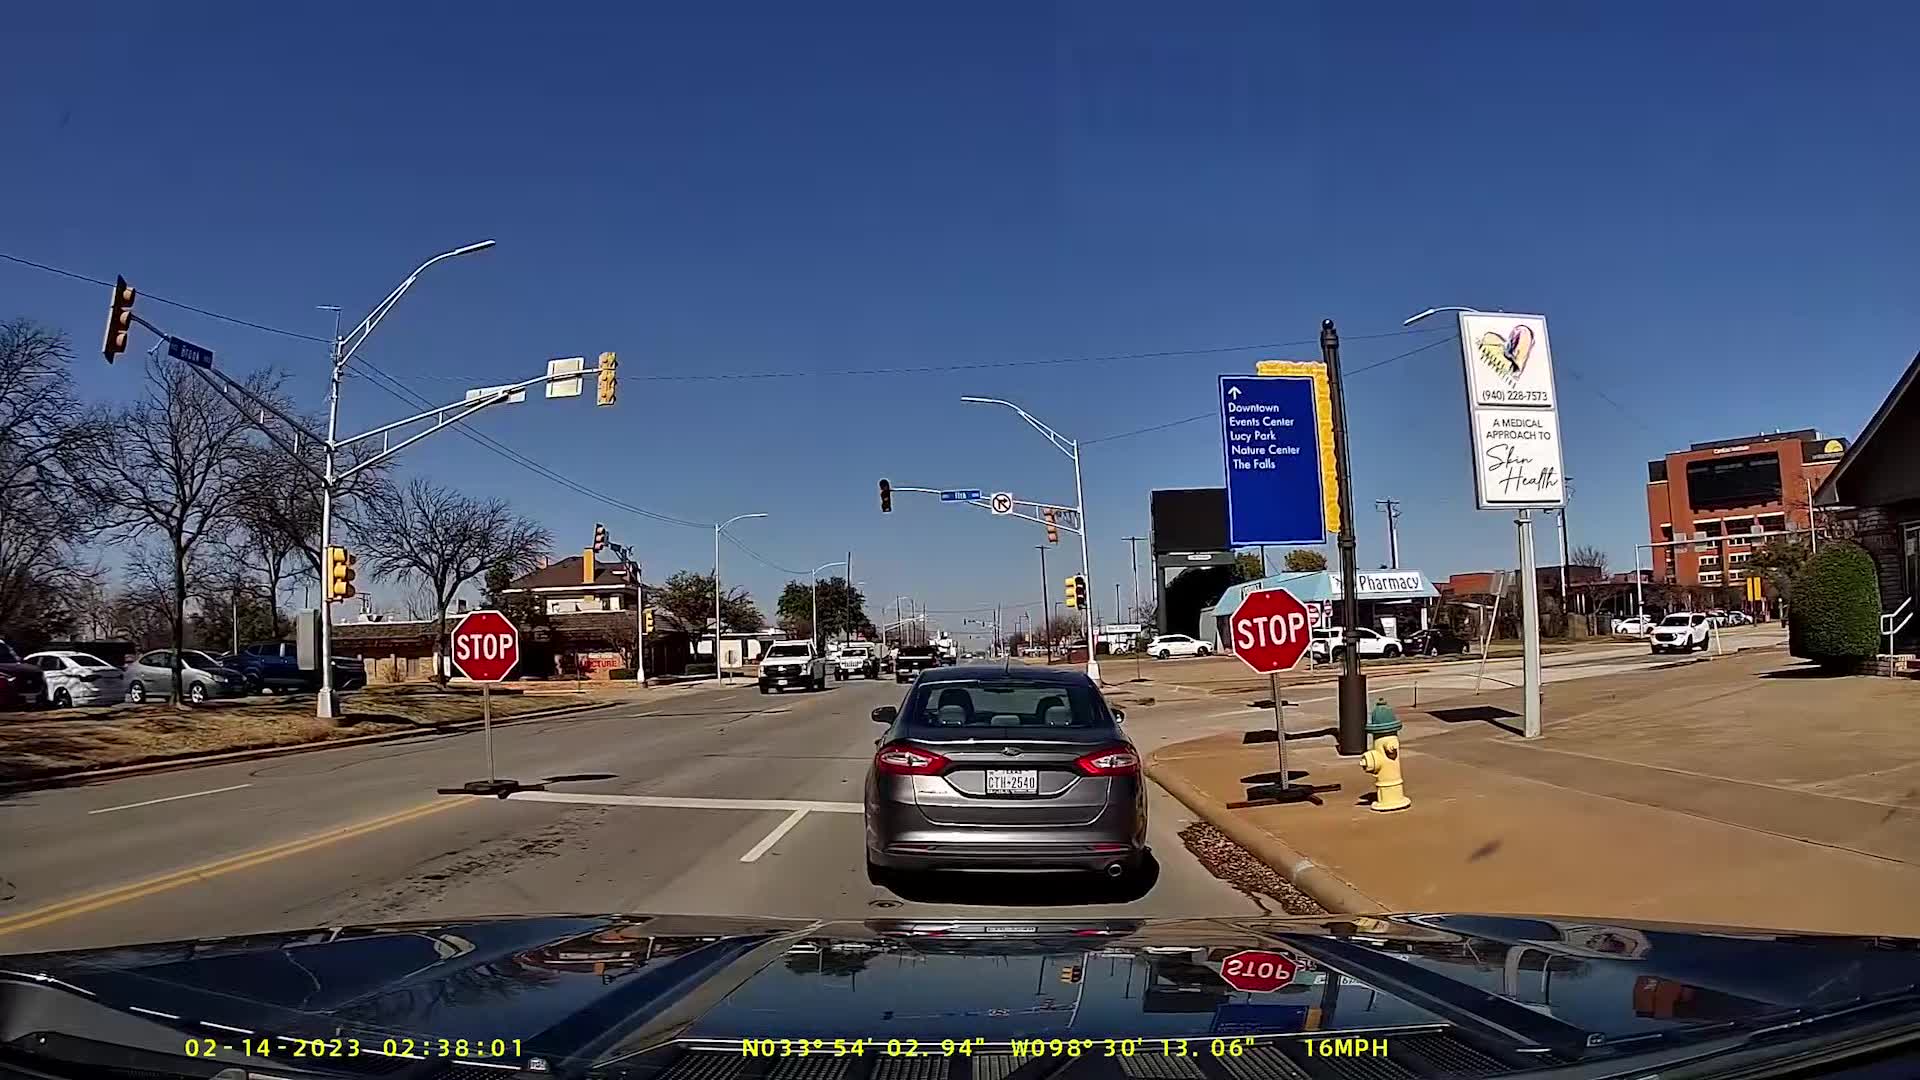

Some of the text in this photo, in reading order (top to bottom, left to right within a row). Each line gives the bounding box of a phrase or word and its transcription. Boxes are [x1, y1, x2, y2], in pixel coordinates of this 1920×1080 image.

[1482, 390, 1548, 401] (940) 228-7573
[1228, 402, 1280, 412] Downtown
[1229, 416, 1294, 426] Events Center
[1493, 418, 1543, 428] A MEDICAL
[1230, 430, 1276, 443] Lucy Park
[1486, 430, 1551, 440] APPROACH TO
[1231, 444, 1300, 455] Nature Center
[1486, 443, 1533, 471] Skin
[1233, 458, 1276, 469] The Falls
[1498, 466, 1559, 495] Health
[1359, 575, 1419, 591] Pharmacy
[1237, 612, 1305, 650] STOP
[457, 633, 513, 660] STOP
